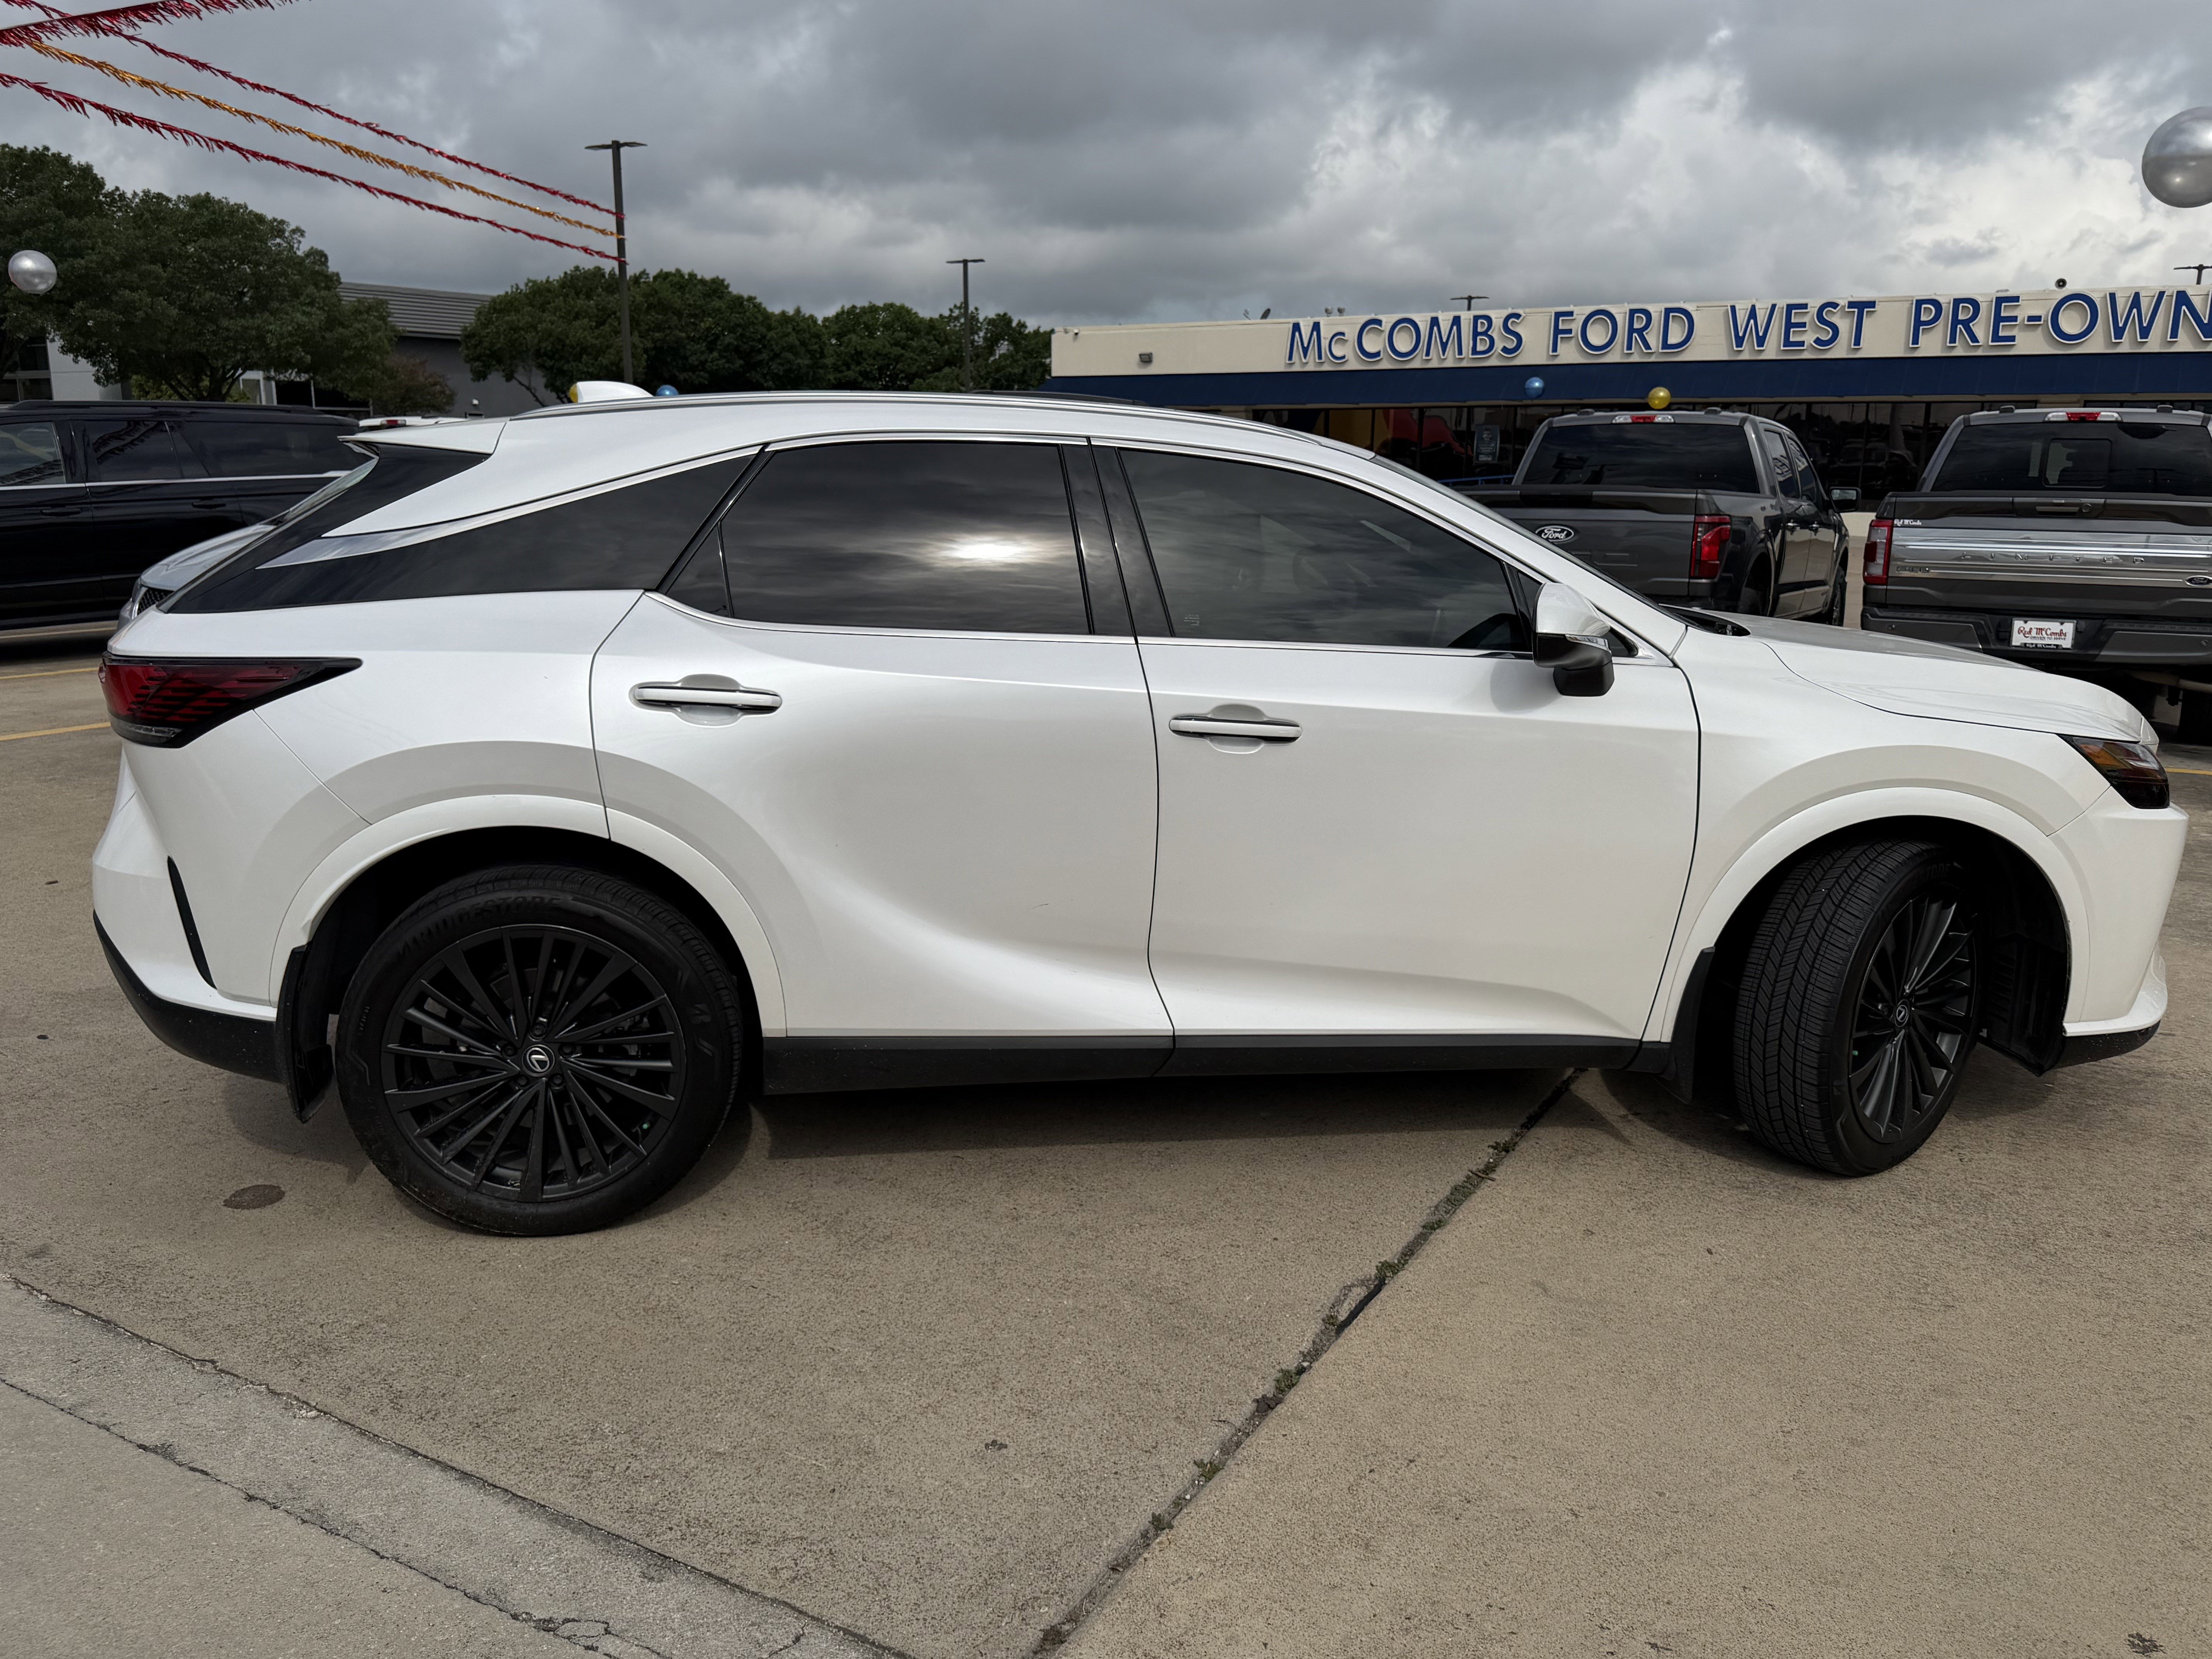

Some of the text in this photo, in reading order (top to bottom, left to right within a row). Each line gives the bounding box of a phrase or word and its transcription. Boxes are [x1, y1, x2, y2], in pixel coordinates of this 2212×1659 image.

[1287, 289, 2212, 363] McCOMBS FORD WEST PRE-OWN
[1961, 551, 2145, 564] LIMITED
[2018, 626, 2067, 638] Red McCombs
